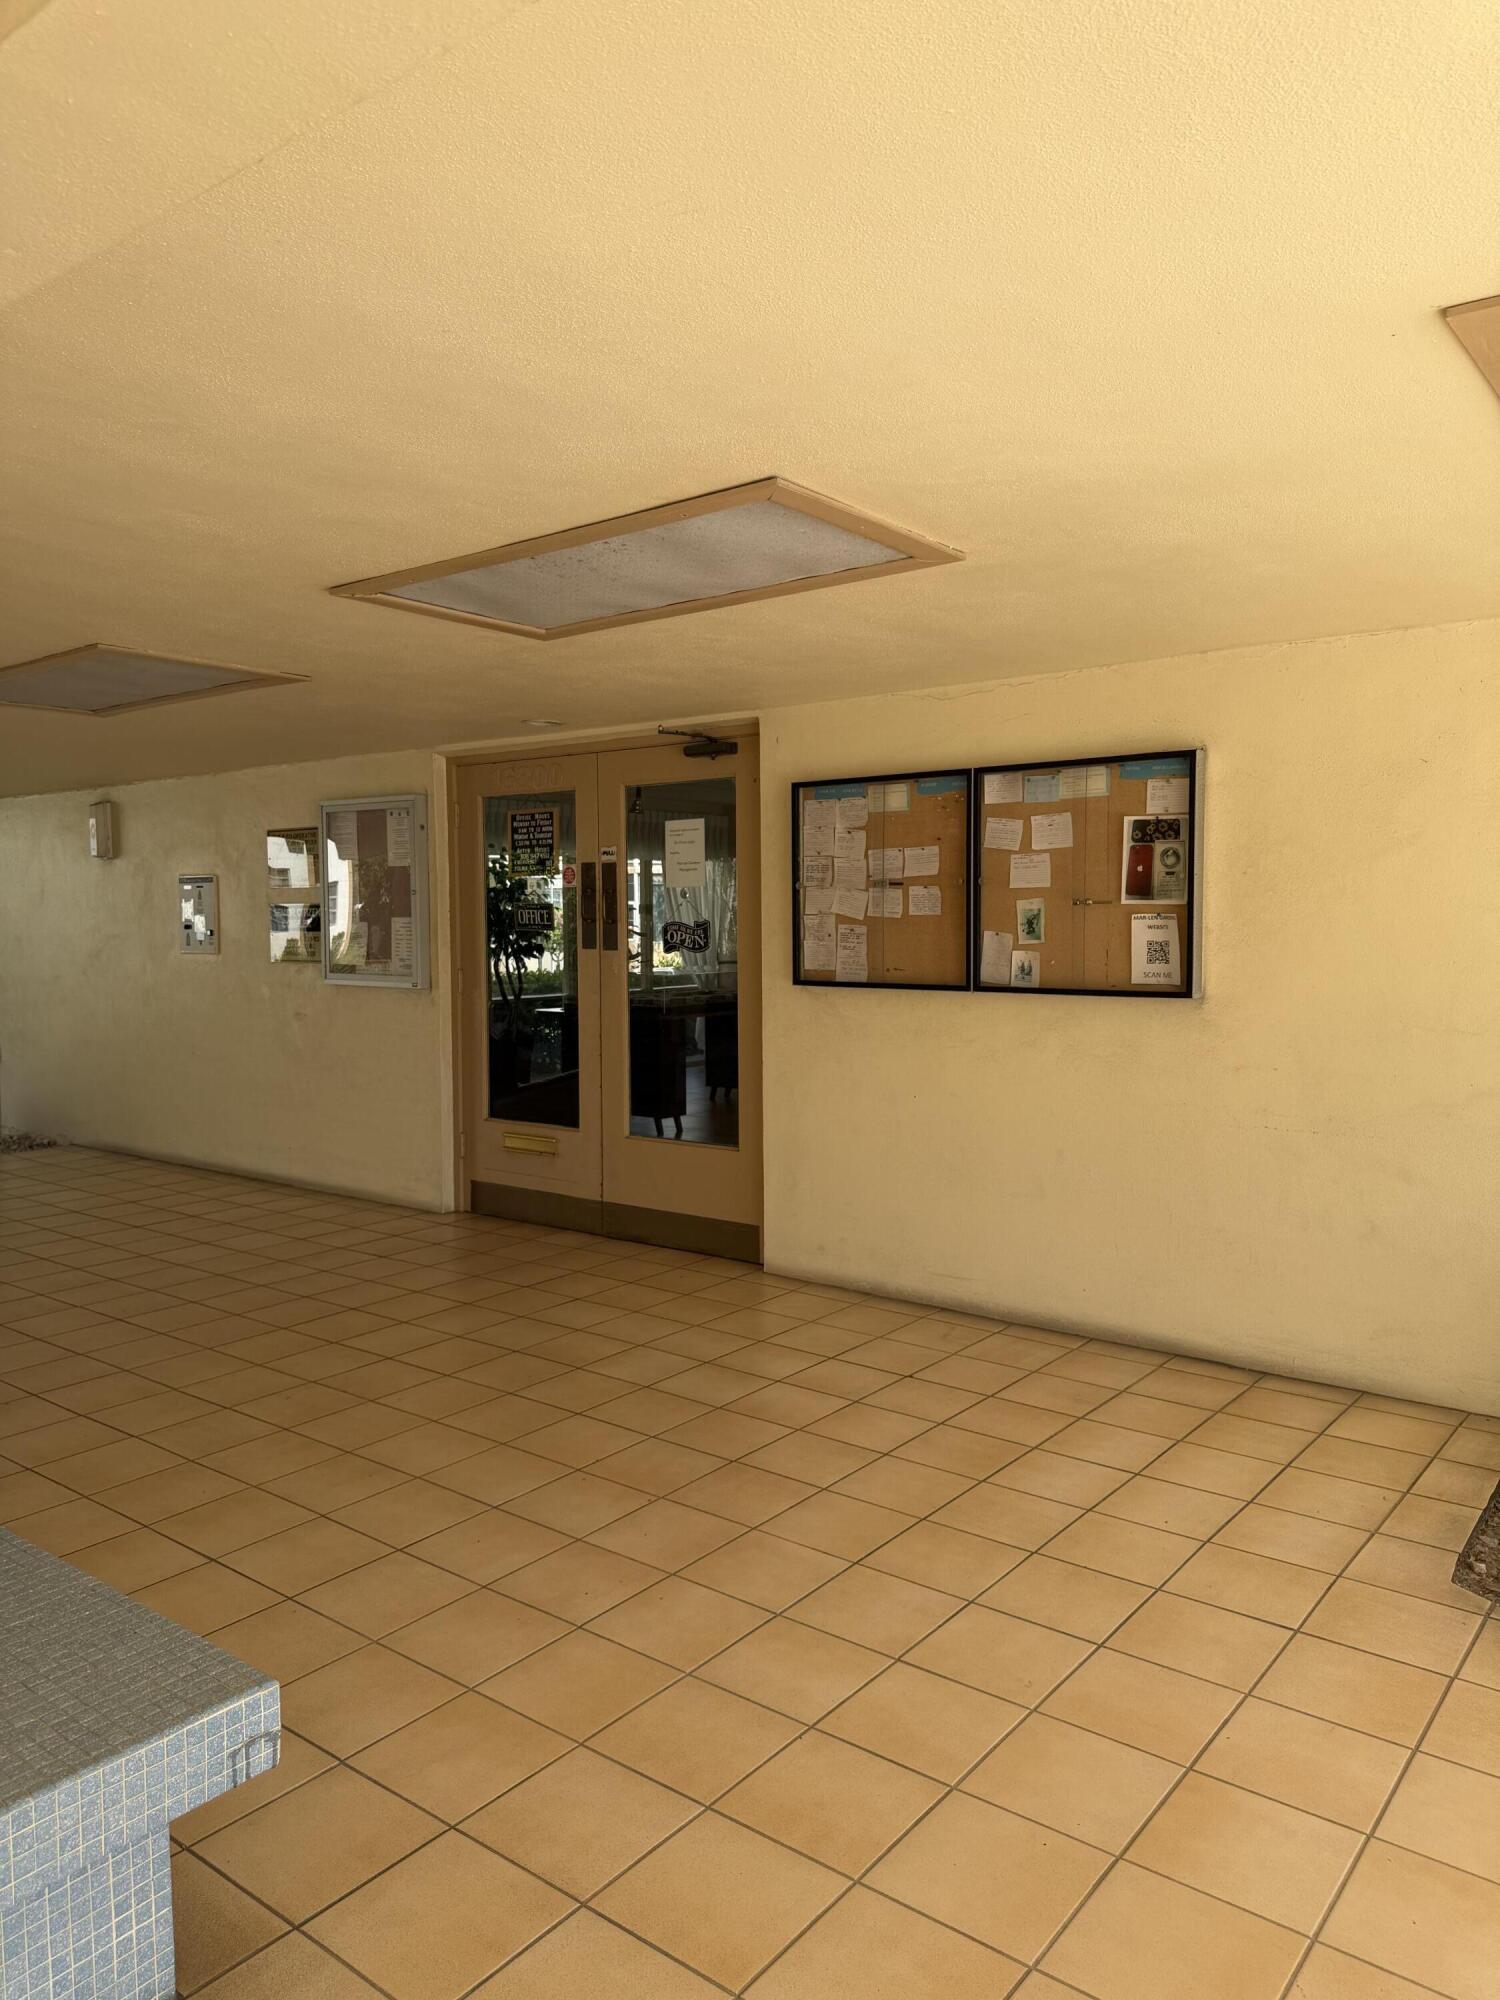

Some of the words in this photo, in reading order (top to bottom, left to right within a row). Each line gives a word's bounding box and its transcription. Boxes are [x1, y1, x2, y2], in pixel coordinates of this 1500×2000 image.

[518, 909, 551, 924] OFFICE
[667, 930, 704, 948] OPEN
[1143, 971, 1162, 979] SCAN
